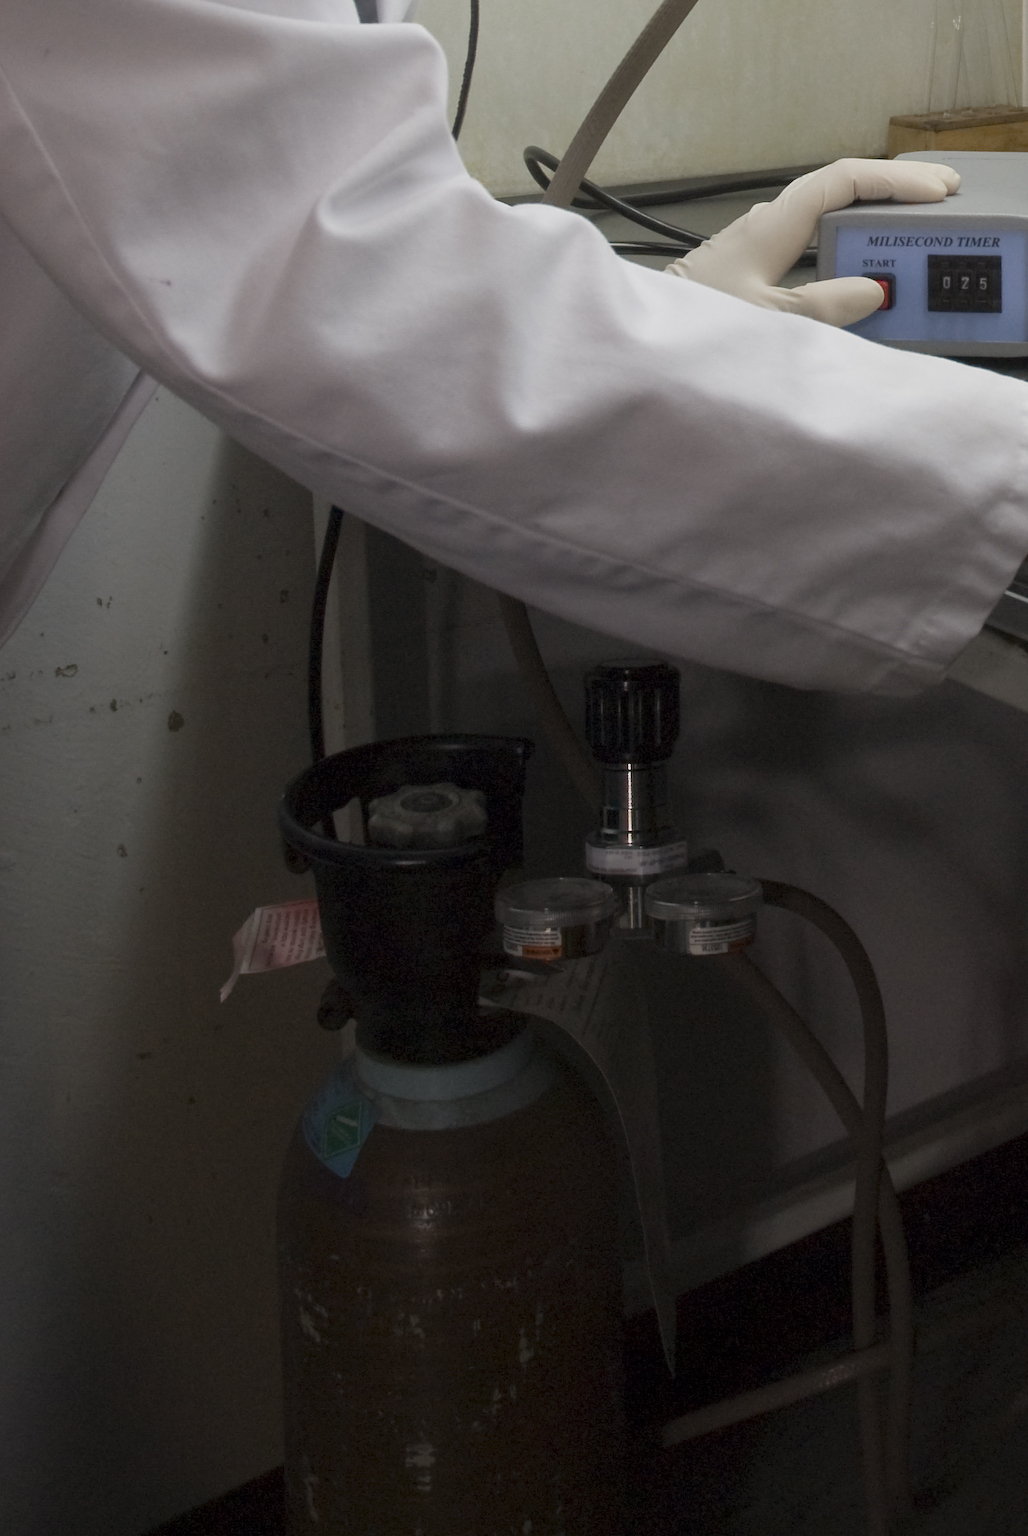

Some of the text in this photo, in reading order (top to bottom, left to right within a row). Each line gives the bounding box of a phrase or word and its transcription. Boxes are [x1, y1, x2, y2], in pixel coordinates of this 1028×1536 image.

[867, 236, 1001, 248] MILISECOND TIMER
[862, 259, 897, 268] START
